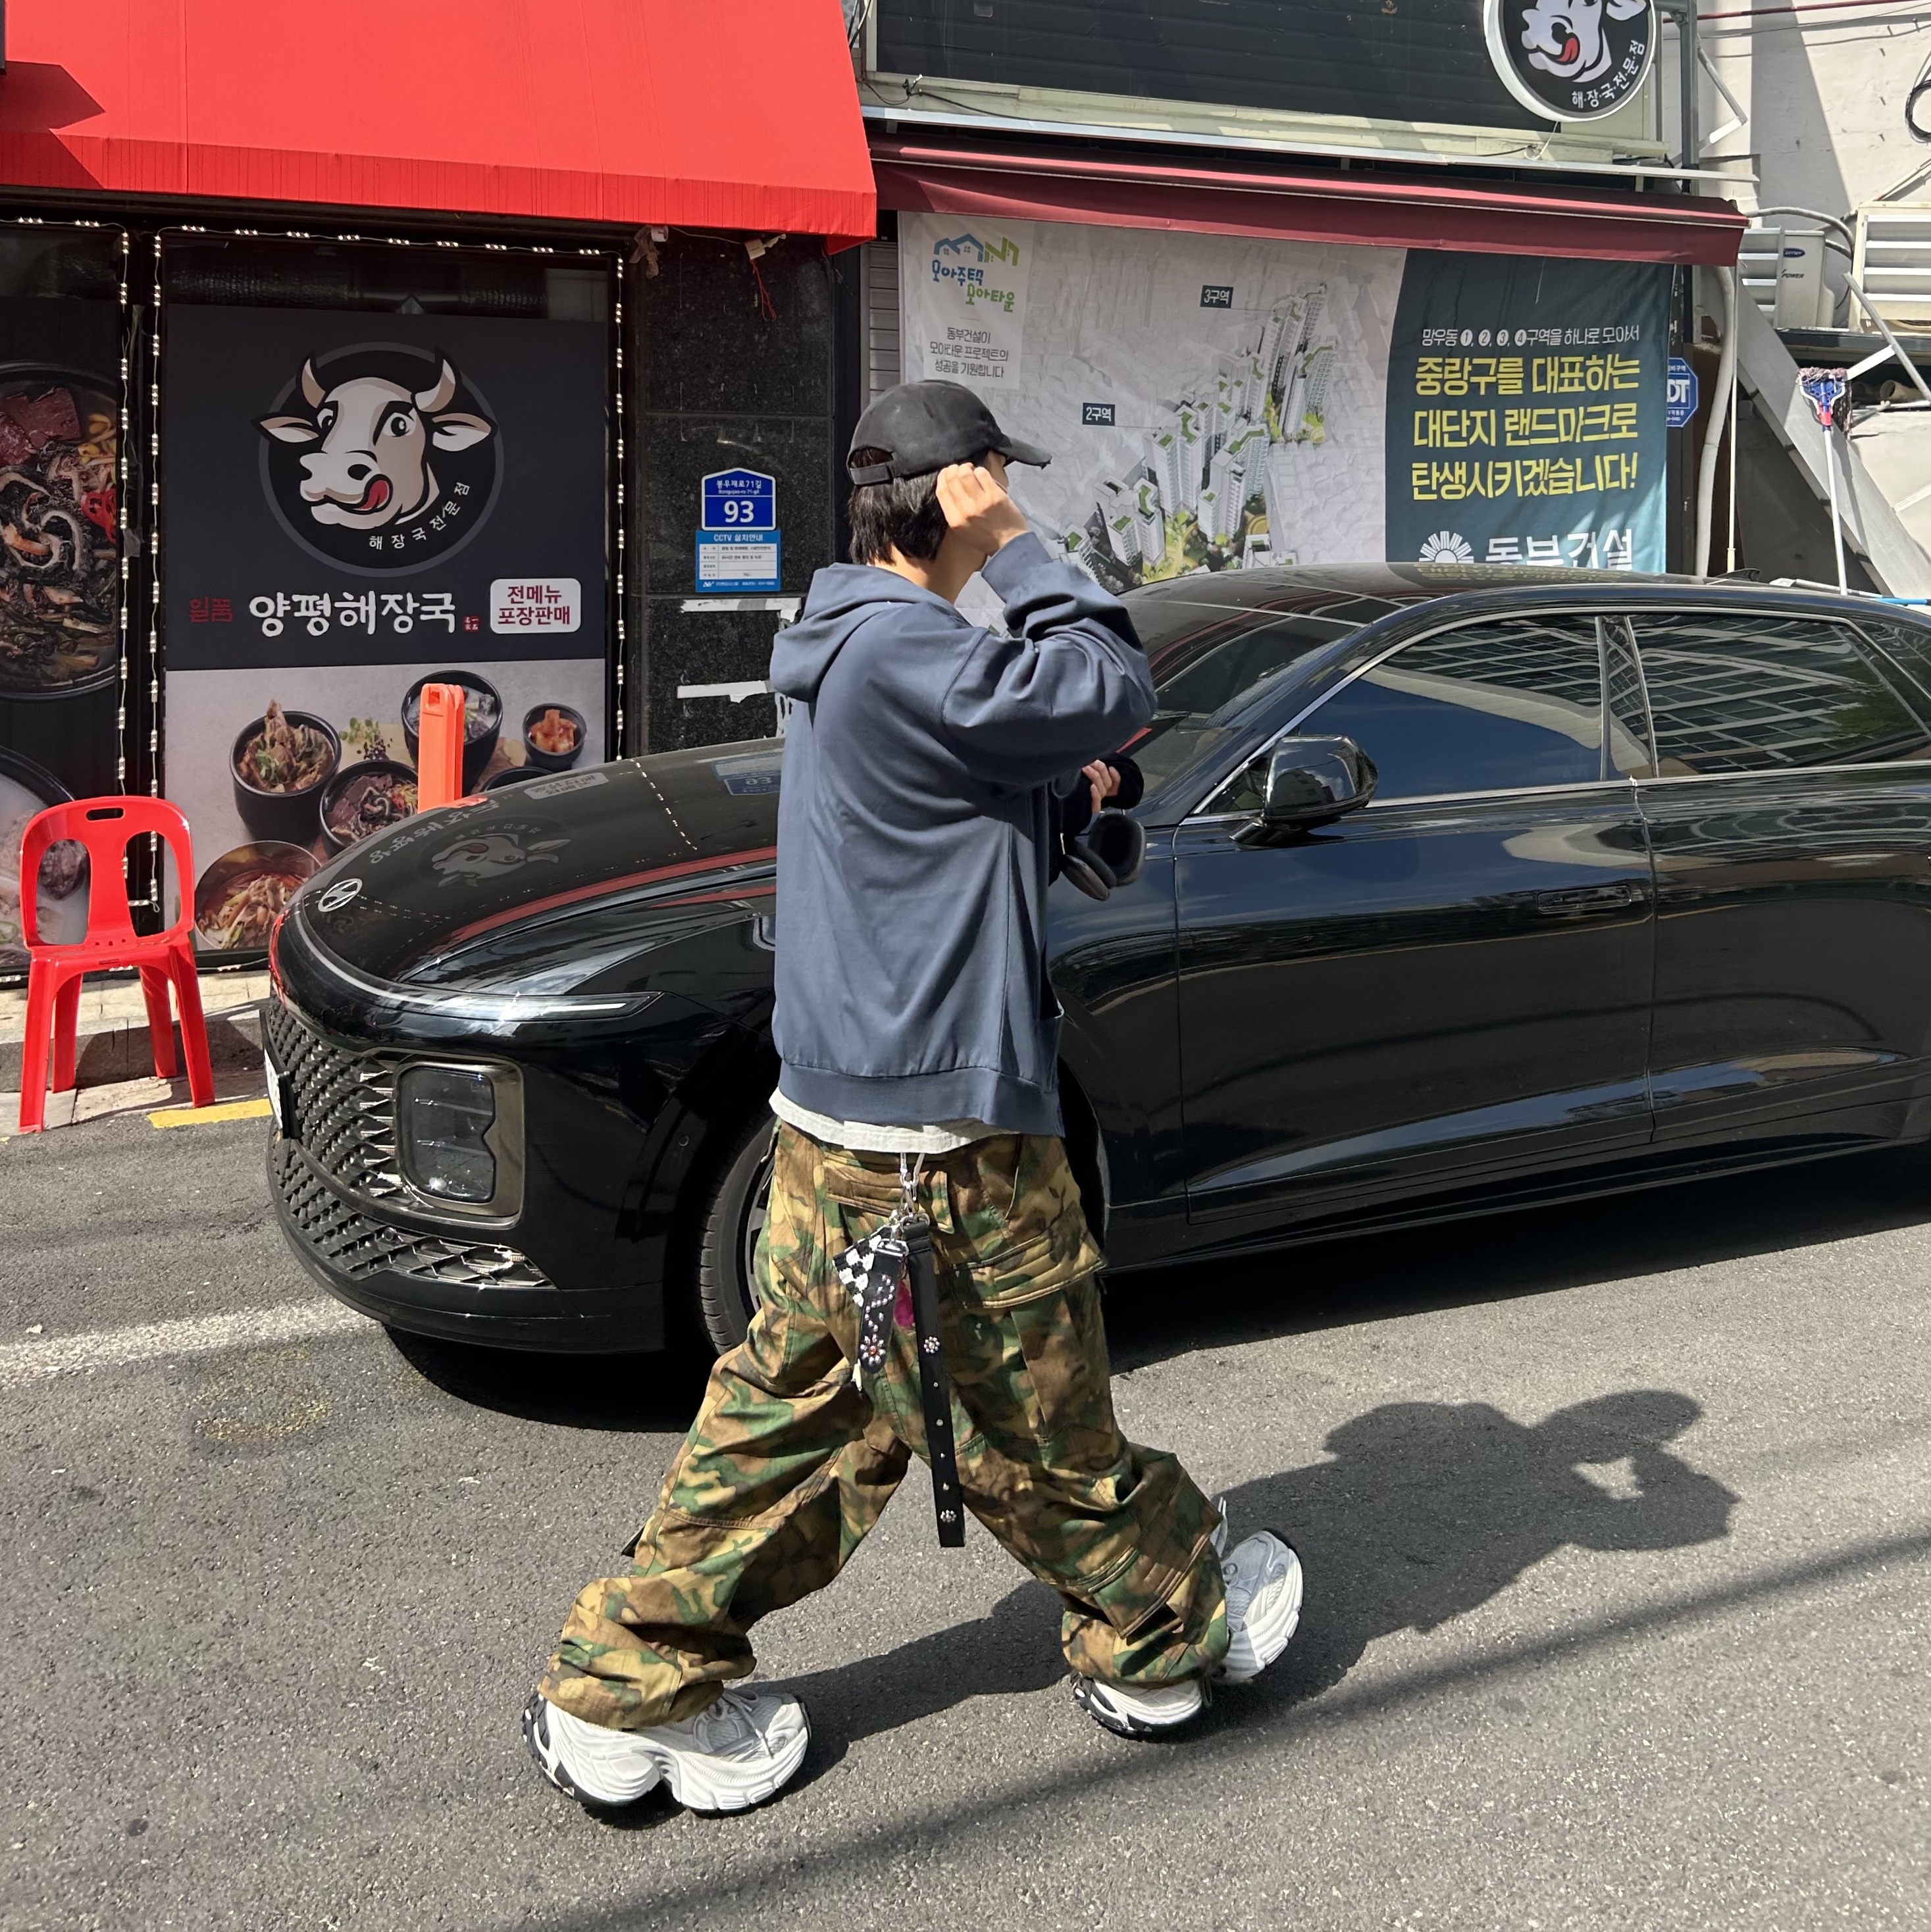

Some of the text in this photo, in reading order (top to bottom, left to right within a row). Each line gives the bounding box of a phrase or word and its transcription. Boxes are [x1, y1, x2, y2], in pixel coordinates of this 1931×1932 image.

[932, 259, 984, 286] 모아주택
[966, 283, 1015, 313] 모아타운
[1204, 289, 1229, 304] 3구역
[947, 327, 991, 343] 동부건설이
[1422, 328, 1458, 347] 망우동
[1564, 327, 1601, 345] 하나로
[1602, 324, 1639, 343] 모아서
[930, 342, 1008, 362] 모아타운 프로젝트의
[935, 359, 1004, 378] 성공을 기원합니다
[1415, 353, 1640, 395] 중랑구를 대표하는
[1666, 378, 1689, 403] DT
[1086, 407, 1112, 422] 2구역
[1413, 403, 1638, 447] 대단지 랜드마크로
[1412, 452, 1638, 501] 탄생시키겠습니다!
[724, 500, 754, 523] 93
[734, 534, 763, 542] 설치안내
[507, 585, 561, 604] 전메뉴
[249, 590, 456, 637] 양평해장국
[498, 606, 570, 626] 포장판매
